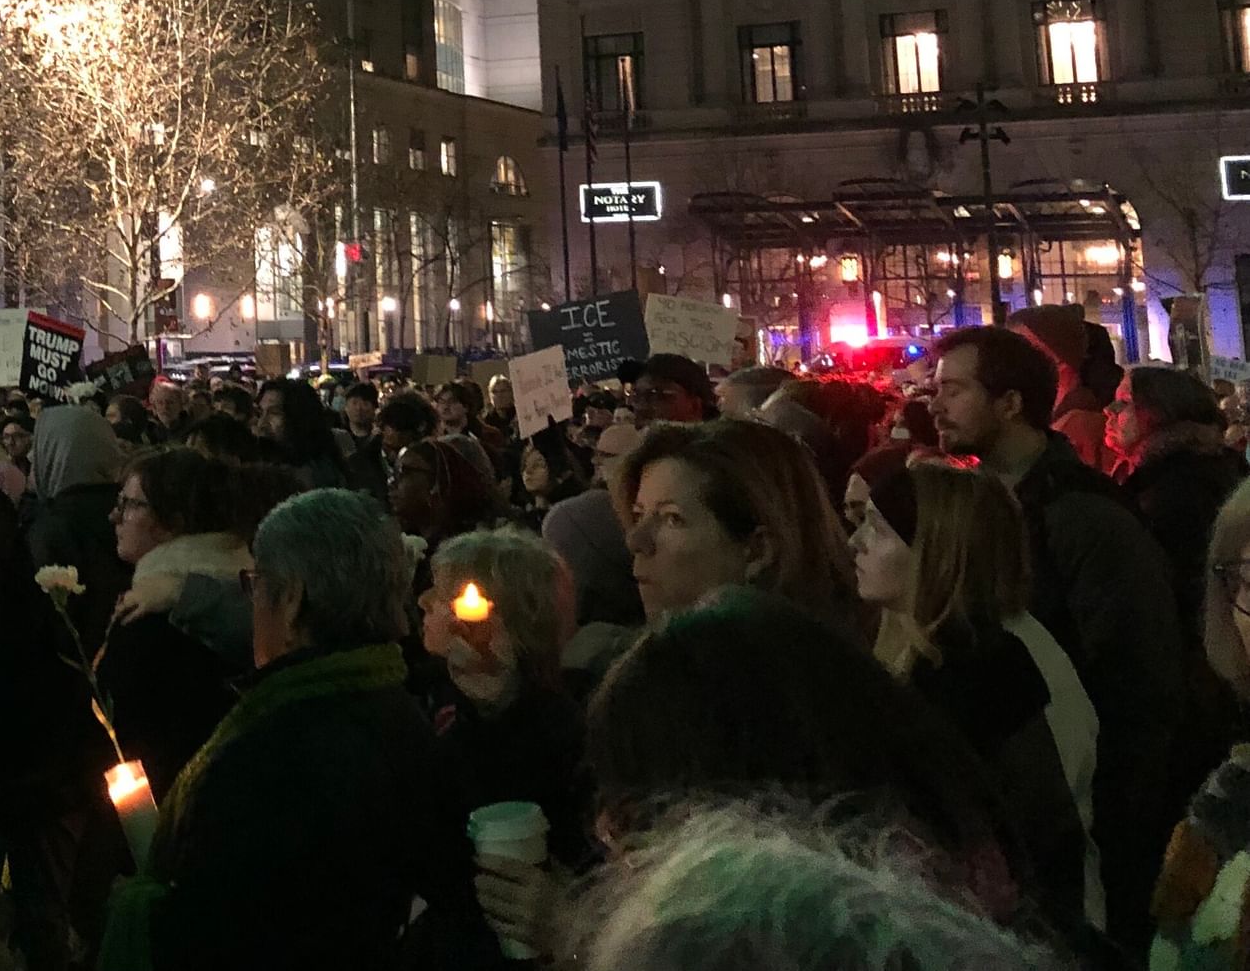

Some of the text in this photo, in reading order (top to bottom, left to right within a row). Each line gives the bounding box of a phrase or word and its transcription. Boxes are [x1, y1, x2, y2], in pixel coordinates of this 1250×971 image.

[593, 194, 646, 205] NOTARY
[560, 300, 617, 331] ICE
[28, 326, 79, 355] TRUMP
[566, 340, 620, 361] MESTIC
[30, 344, 71, 371] MUST
[37, 363, 57, 382] GO
[29, 375, 64, 402] NOW!
